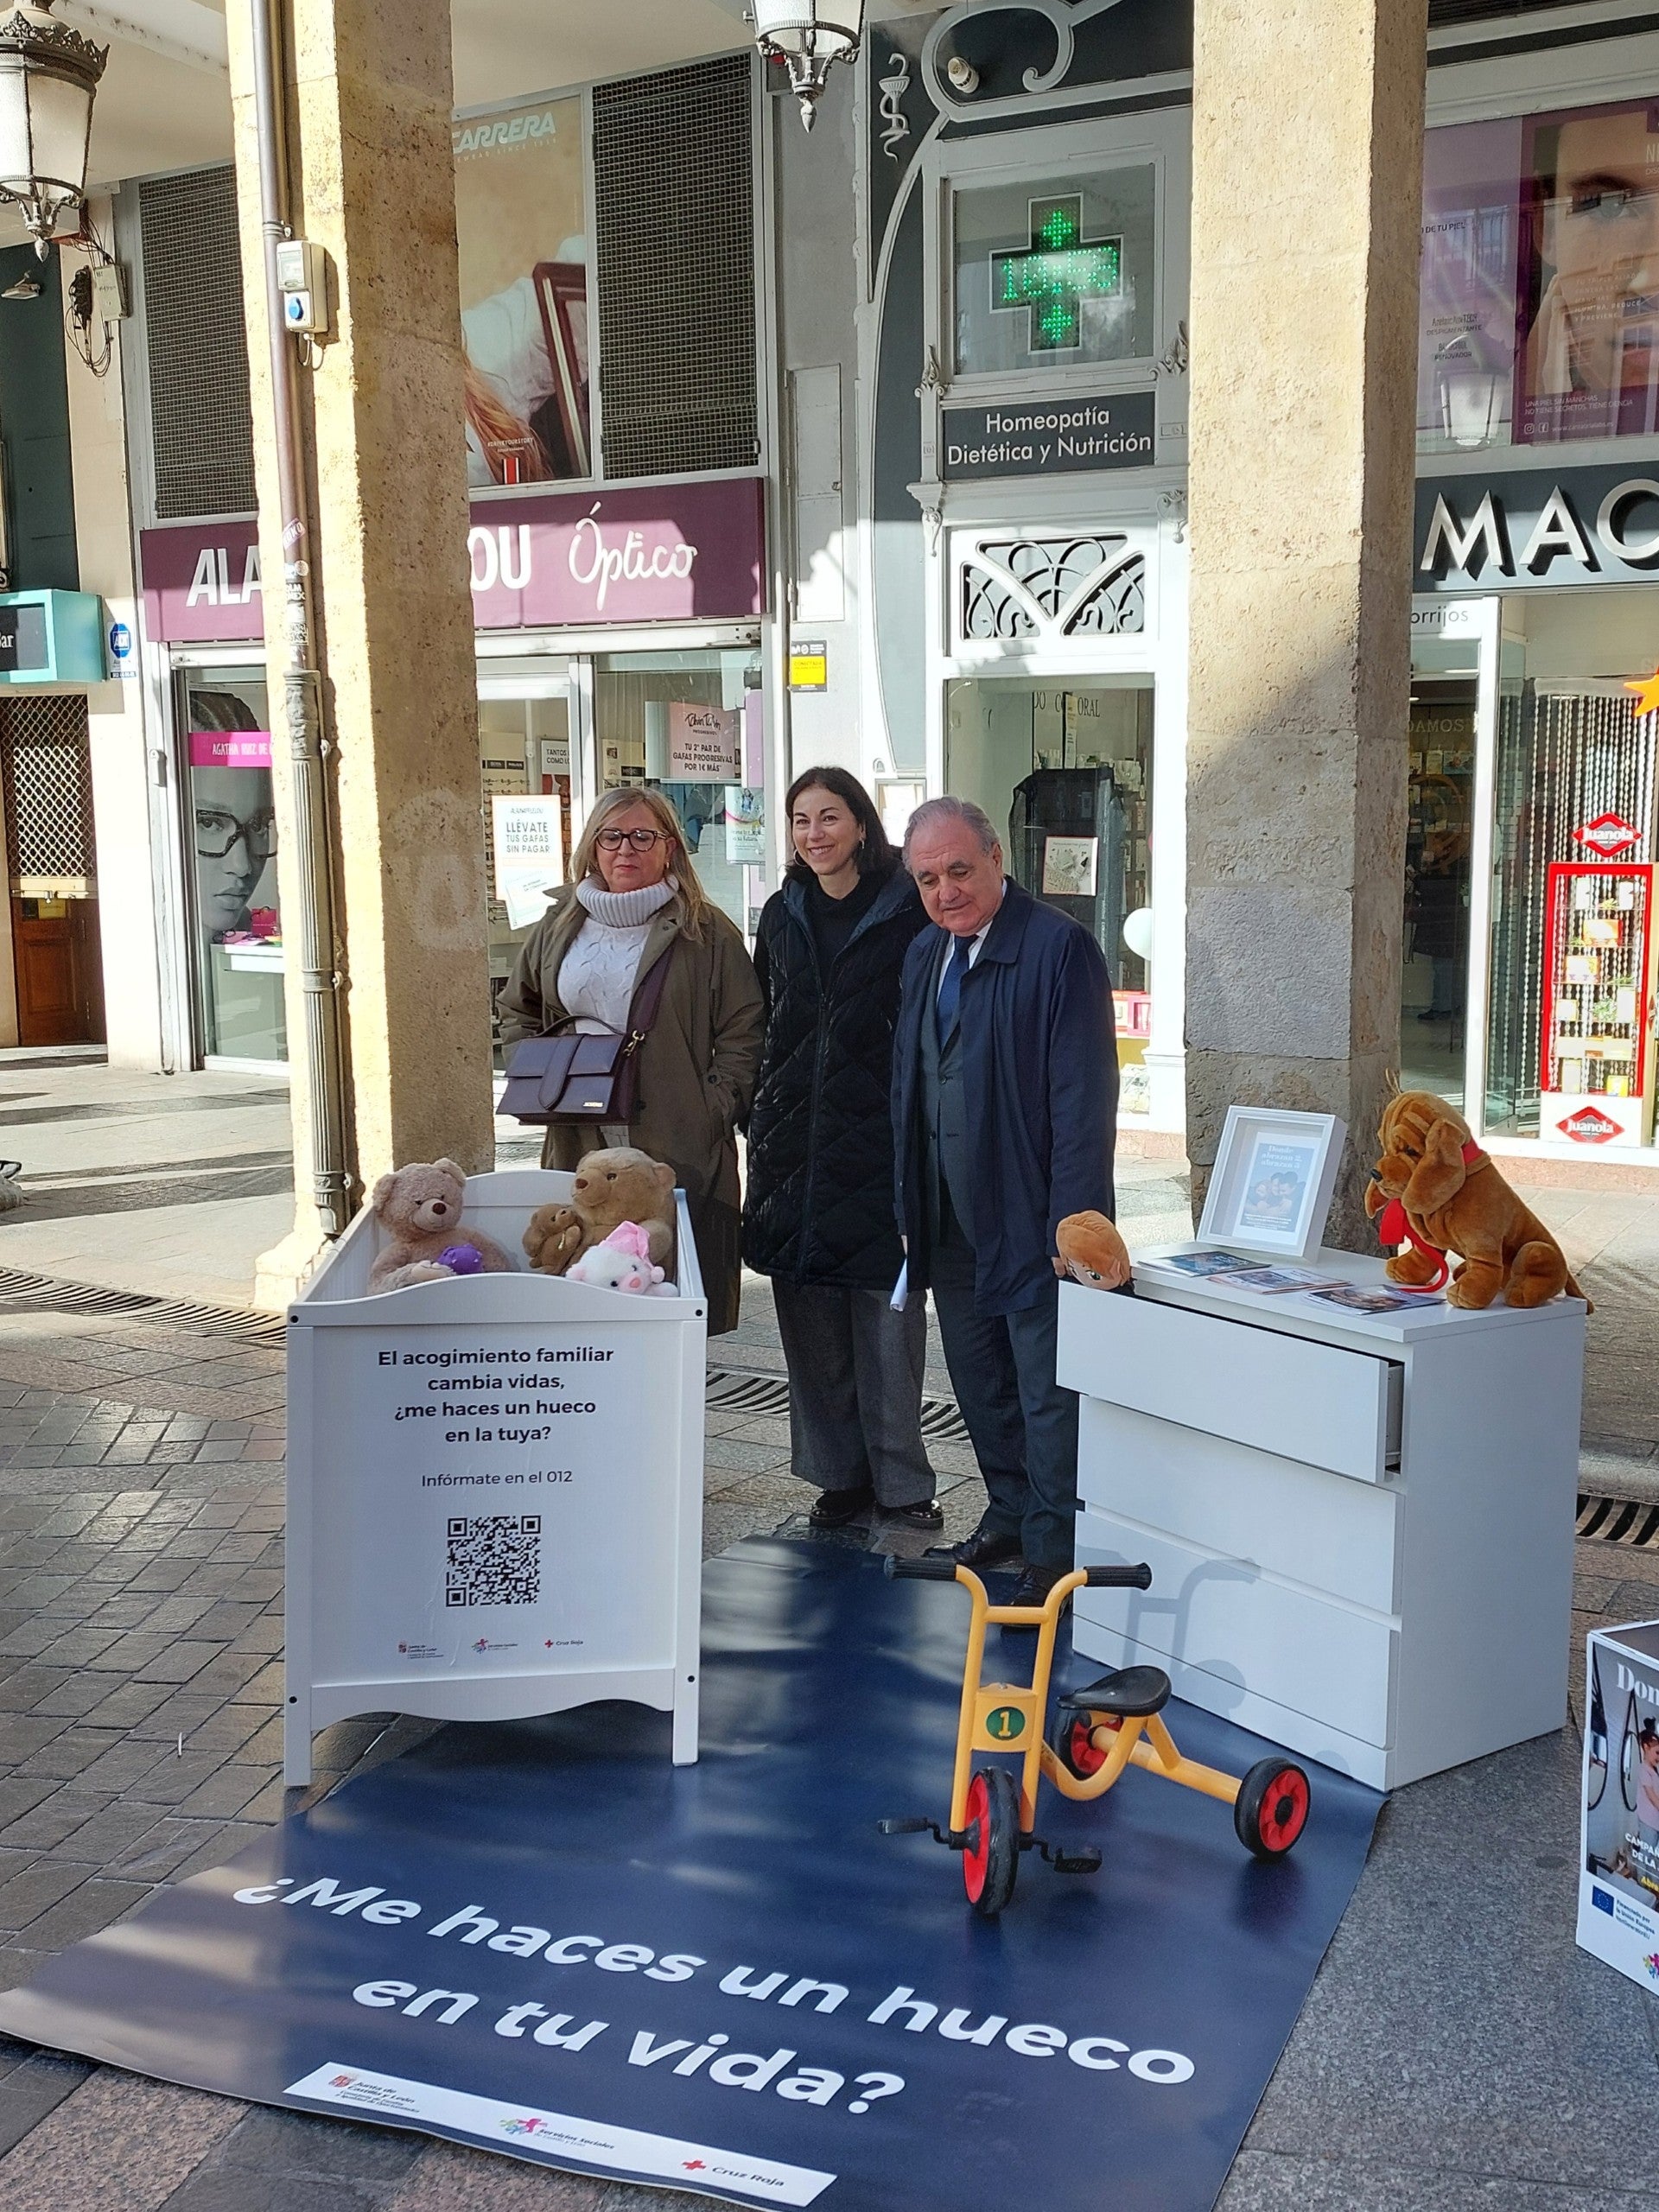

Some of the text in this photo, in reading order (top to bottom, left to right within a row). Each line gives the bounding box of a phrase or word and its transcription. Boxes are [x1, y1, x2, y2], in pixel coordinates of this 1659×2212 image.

[986, 406, 1110, 433] Homeopatía
[948, 433, 1152, 465] Dietética y Nutrición
[0, 632, 15, 649] ar
[694, 753, 733, 764] PROGRESIVAS
[505, 818, 549, 833] LLÉVATE
[1566, 1118, 1615, 1134] Juanola
[378, 1346, 614, 1368] El acogimiento familiar
[428, 1373, 565, 1391] cambia vidas,
[394, 1400, 596, 1421] ¿me haces un hueco
[445, 1426, 552, 1445] en la tuya?
[422, 1471, 574, 1487] Infórmate en el 012
[998, 1711, 1012, 1737] 1
[1632, 1849, 1656, 1870] DE LA
[232, 1878, 1196, 2084] ¿Me haces un hueco
[353, 1980, 906, 2114] en tu vida?
[355, 2082, 383, 2091] Junta
[538, 2128, 615, 2150] Servicios Sociales
[712, 2166, 785, 2187] Cruz Roja
